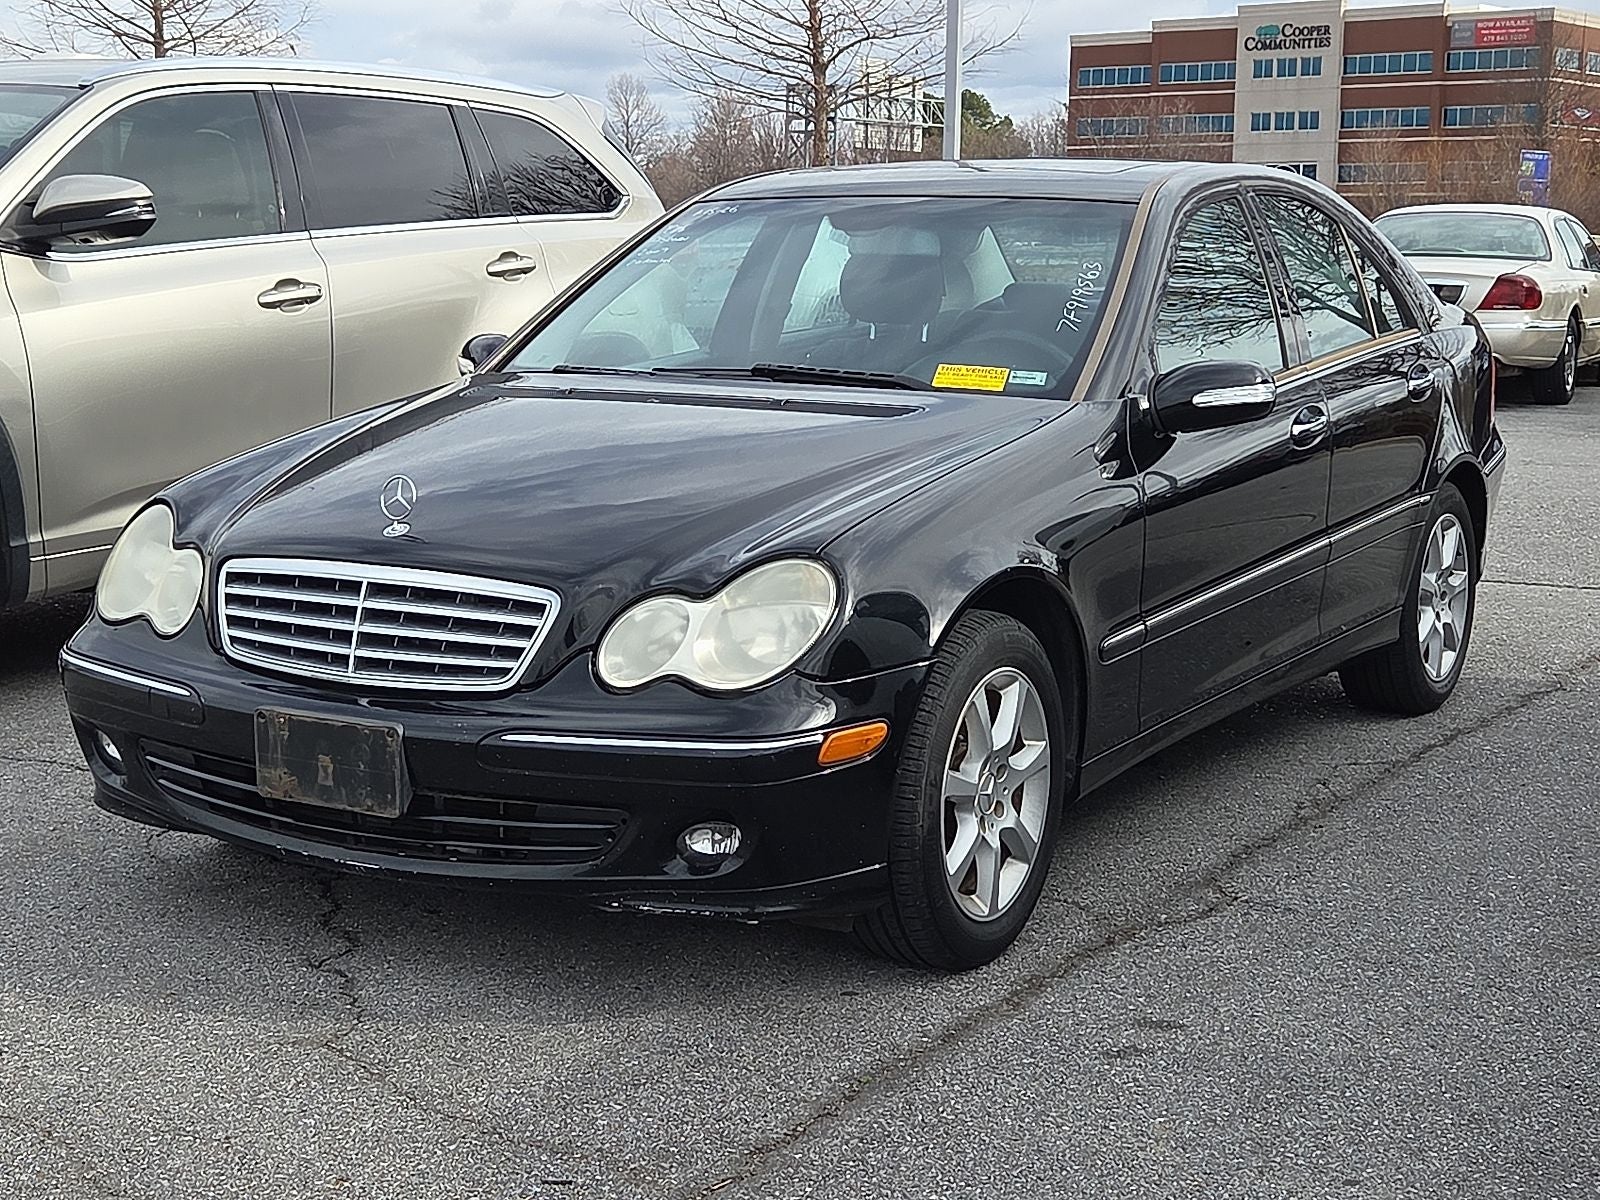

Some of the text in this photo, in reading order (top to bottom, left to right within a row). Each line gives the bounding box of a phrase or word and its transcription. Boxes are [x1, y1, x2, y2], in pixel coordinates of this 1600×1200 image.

[1495, 19, 1534, 28] AVAILABLE
[1281, 23, 1331, 37] COOPER
[1244, 36, 1331, 51] COMMUNITIES
[965, 367, 1007, 376] VEHICLE
